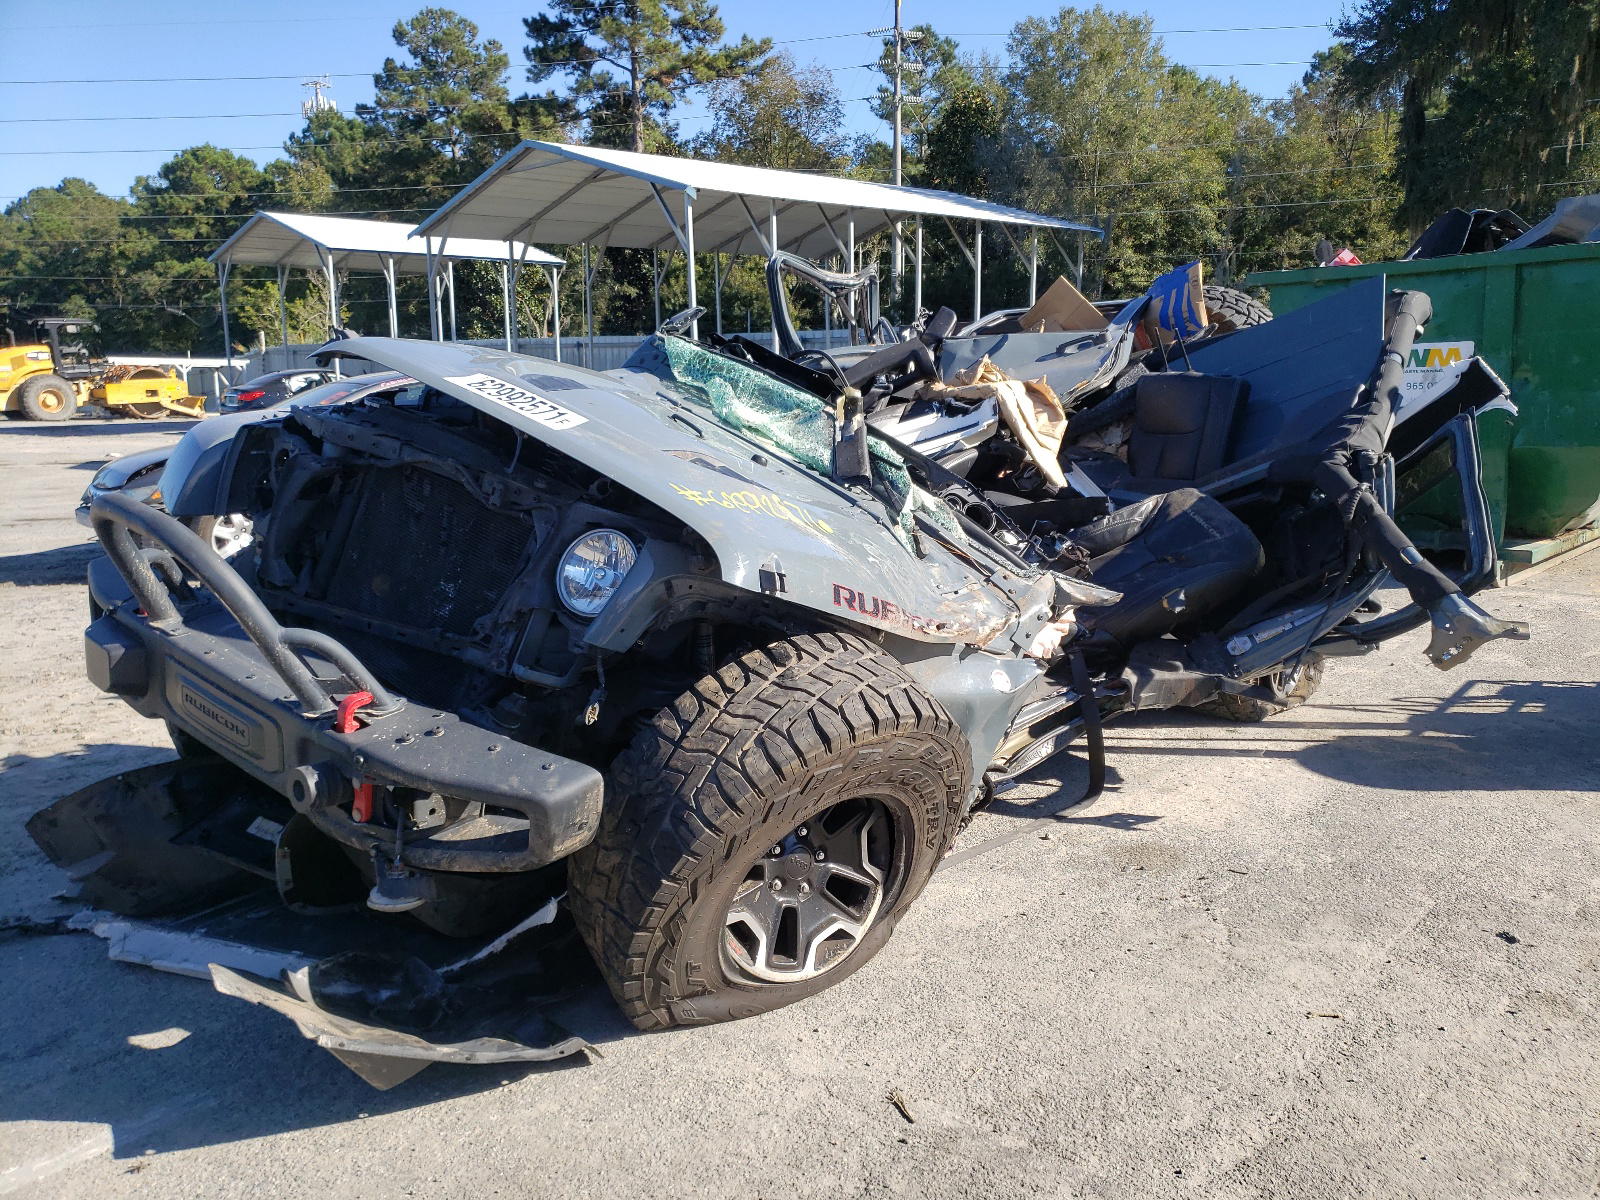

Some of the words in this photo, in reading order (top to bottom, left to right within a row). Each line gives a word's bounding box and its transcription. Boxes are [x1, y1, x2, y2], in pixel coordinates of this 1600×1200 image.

[467, 379, 568, 421] 62992571
[1406, 382, 1424, 390] 965
[185, 693, 246, 738] RUBICON
